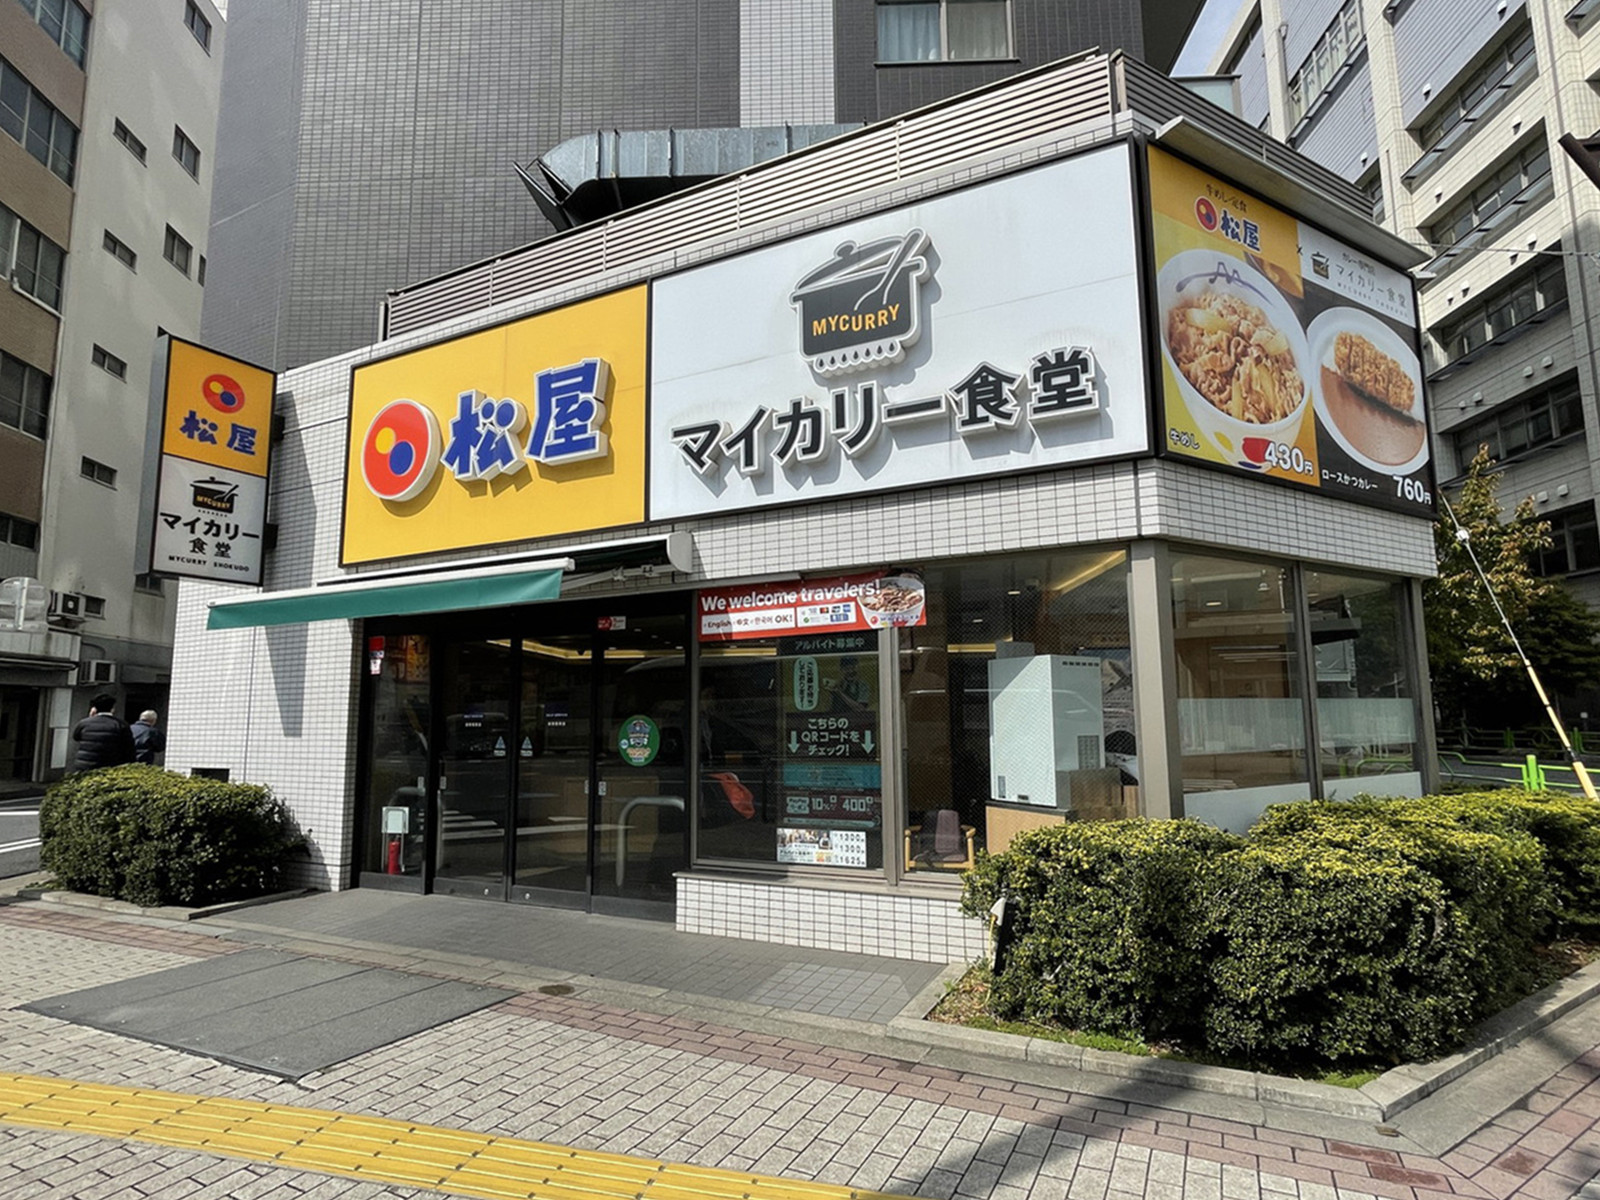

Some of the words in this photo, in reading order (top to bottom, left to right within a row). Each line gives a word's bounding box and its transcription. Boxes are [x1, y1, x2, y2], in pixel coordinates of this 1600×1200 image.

[1220, 209, 1260, 252] 松屋
[811, 302, 901, 338] MYCURRY
[444, 357, 606, 480] 松屋
[671, 346, 1094, 472] マイカリー食堂
[179, 409, 257, 456] 松屋
[1169, 428, 1200, 451] 牛めし
[1264, 441, 1314, 476] 430円
[1321, 468, 1379, 490] ロースかつカレー
[1392, 475, 1432, 505] 760円
[196, 494, 231, 509] MYCURRY
[160, 511, 260, 541] マイカリー
[189, 536, 232, 559] 食堂
[168, 555, 207, 567] MYCURRY
[213, 561, 250, 573] SHOKUDO
[701, 595, 727, 612] We
[729, 587, 798, 610] welcome
[801, 578, 882, 602] travelers!
[707, 619, 731, 630] English
[775, 613, 793, 624] OK!
[807, 717, 849, 730] こちらの
[800, 730, 860, 744] QRコードを
[807, 744, 850, 757] チェック!
